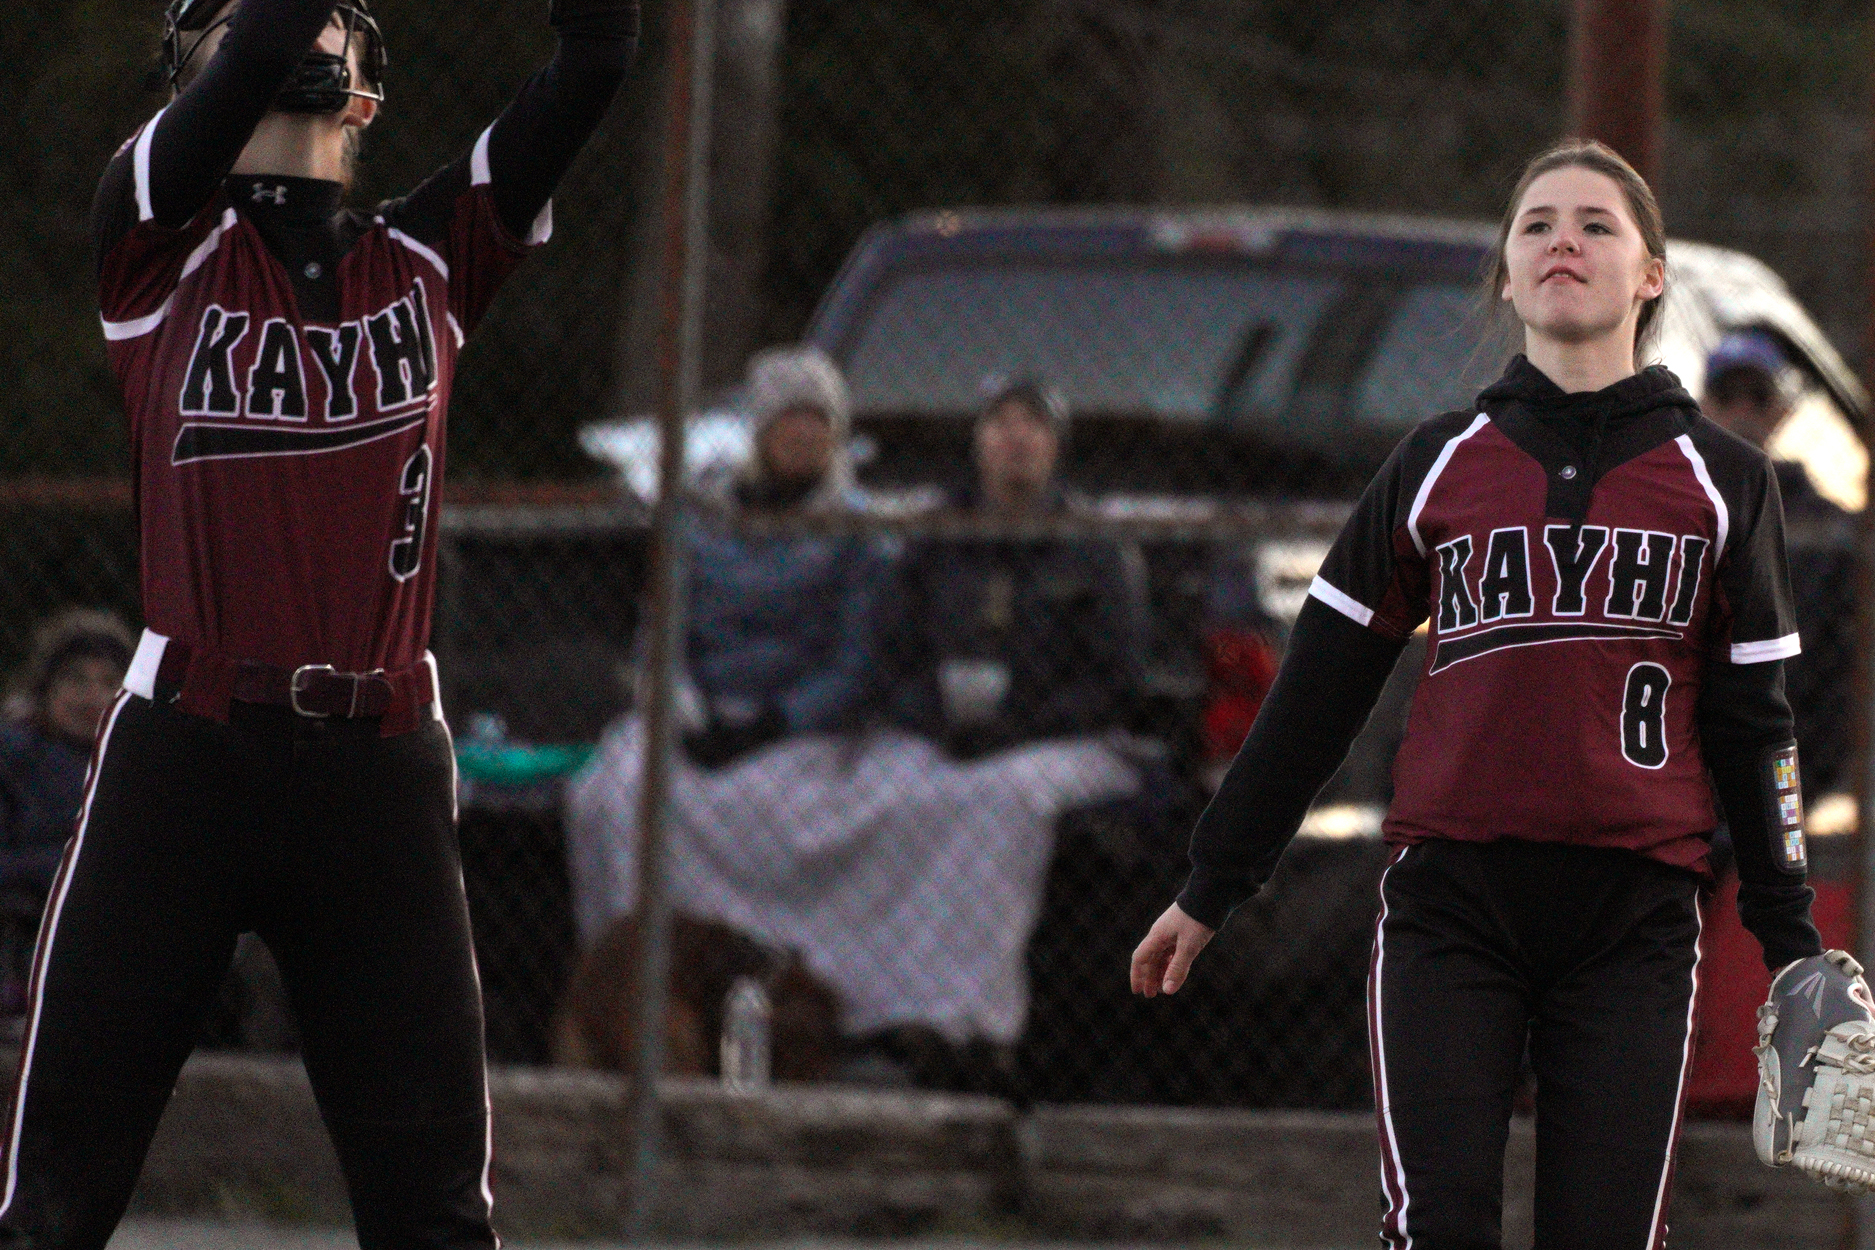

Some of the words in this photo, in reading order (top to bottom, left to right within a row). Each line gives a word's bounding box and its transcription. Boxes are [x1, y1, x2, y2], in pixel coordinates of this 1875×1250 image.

[388, 443, 433, 583] 3
[1435, 524, 1710, 635] KAYHI
[1620, 661, 1671, 770] 8
